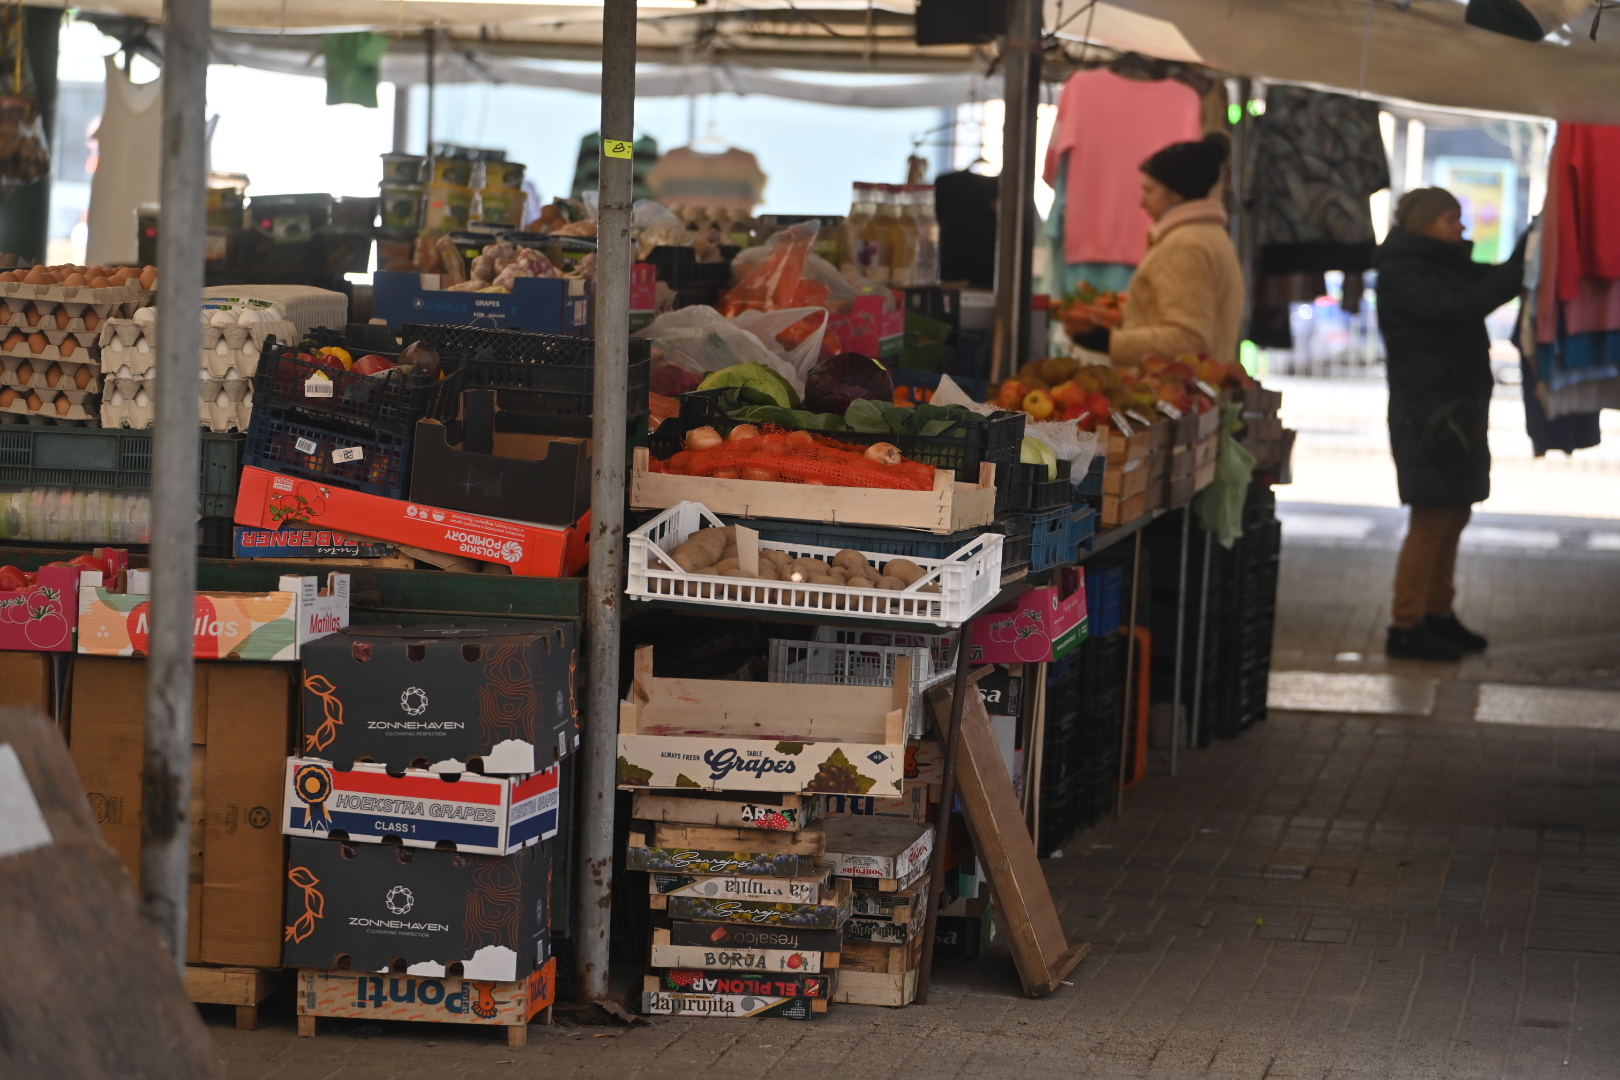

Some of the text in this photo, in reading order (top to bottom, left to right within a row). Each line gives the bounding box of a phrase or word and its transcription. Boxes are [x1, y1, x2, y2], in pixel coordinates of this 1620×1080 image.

[444, 530, 502, 548] POMIDORY
[316, 546, 360, 556] Frutas
[310, 612, 341, 634] Matillas
[368, 722, 464, 730] ZONNEHAVEN
[704, 748, 796, 780] Grapes
[336, 794, 496, 822] HOEKSTRA GRAPES
[374, 820, 416, 834] CLASS 1
[841, 866, 884, 878] Sonrojas
[348, 917, 448, 932] ZONNEHAVEN
[704, 952, 767, 969] BORJA
[357, 976, 464, 1014] Ponti
[692, 978, 798, 996] EL PILONAR
